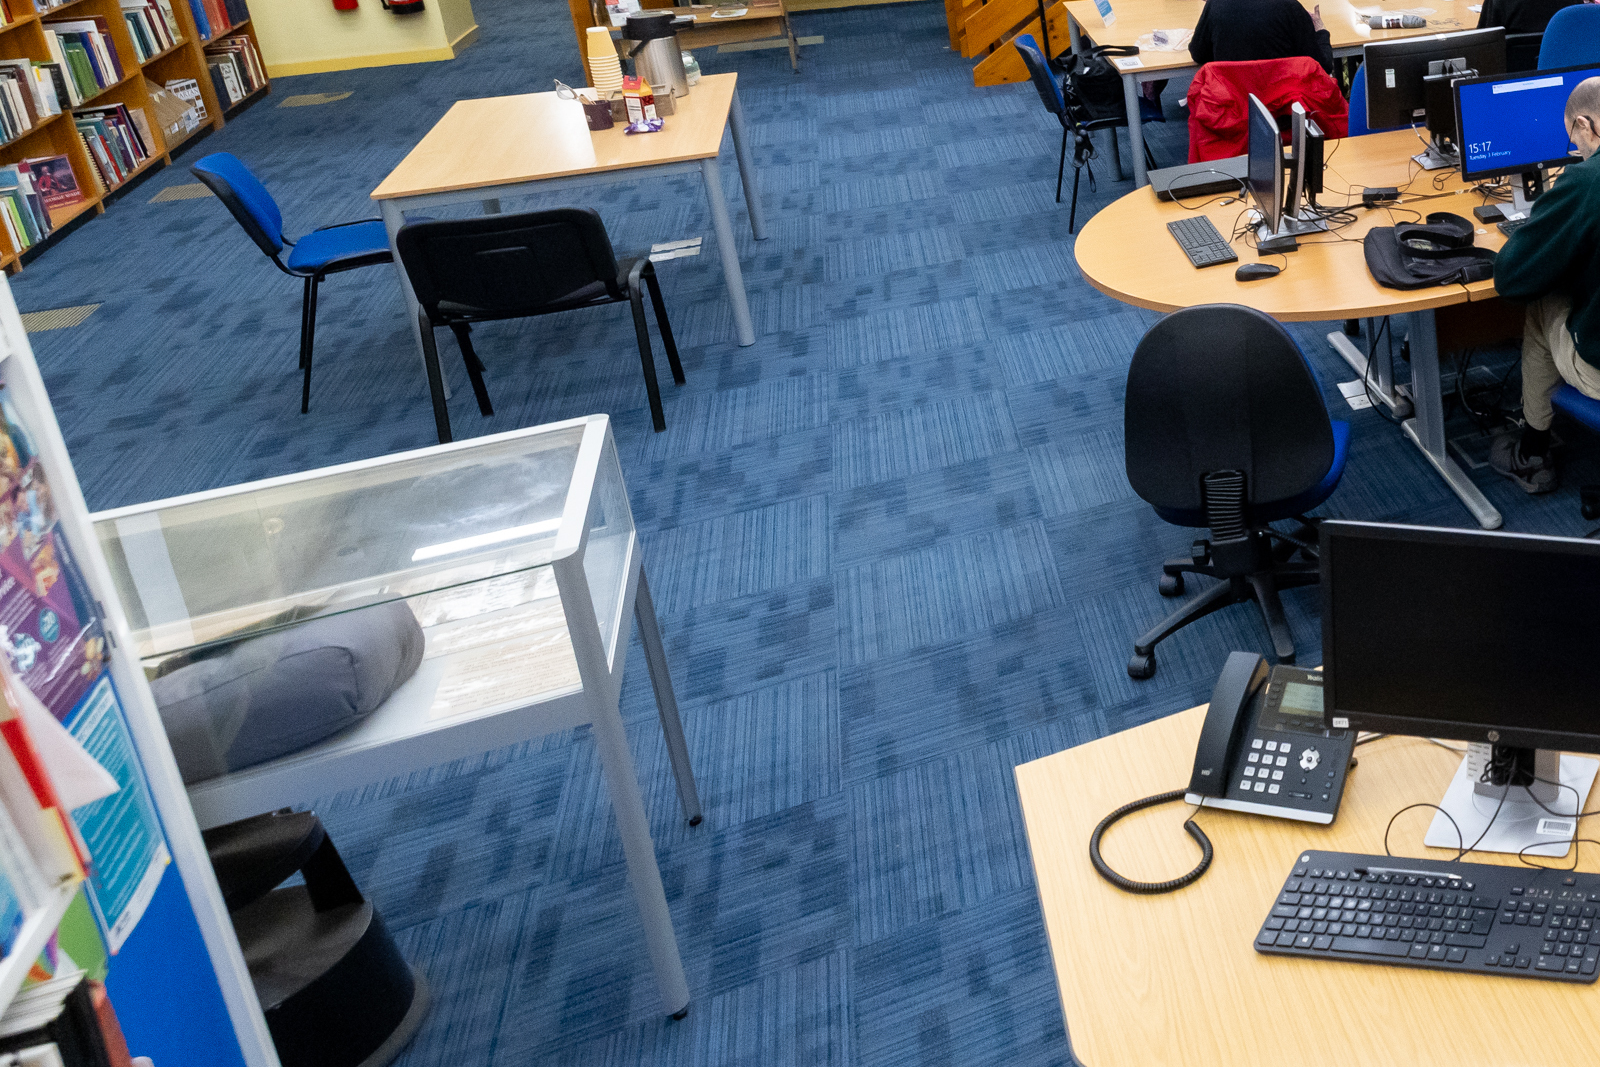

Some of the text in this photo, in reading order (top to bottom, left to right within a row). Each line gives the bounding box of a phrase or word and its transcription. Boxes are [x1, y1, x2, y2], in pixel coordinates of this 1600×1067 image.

[1468, 141, 1492, 154] 15:17
[1469, 152, 1487, 161] Tuesday
[1491, 150, 1512, 158] February
